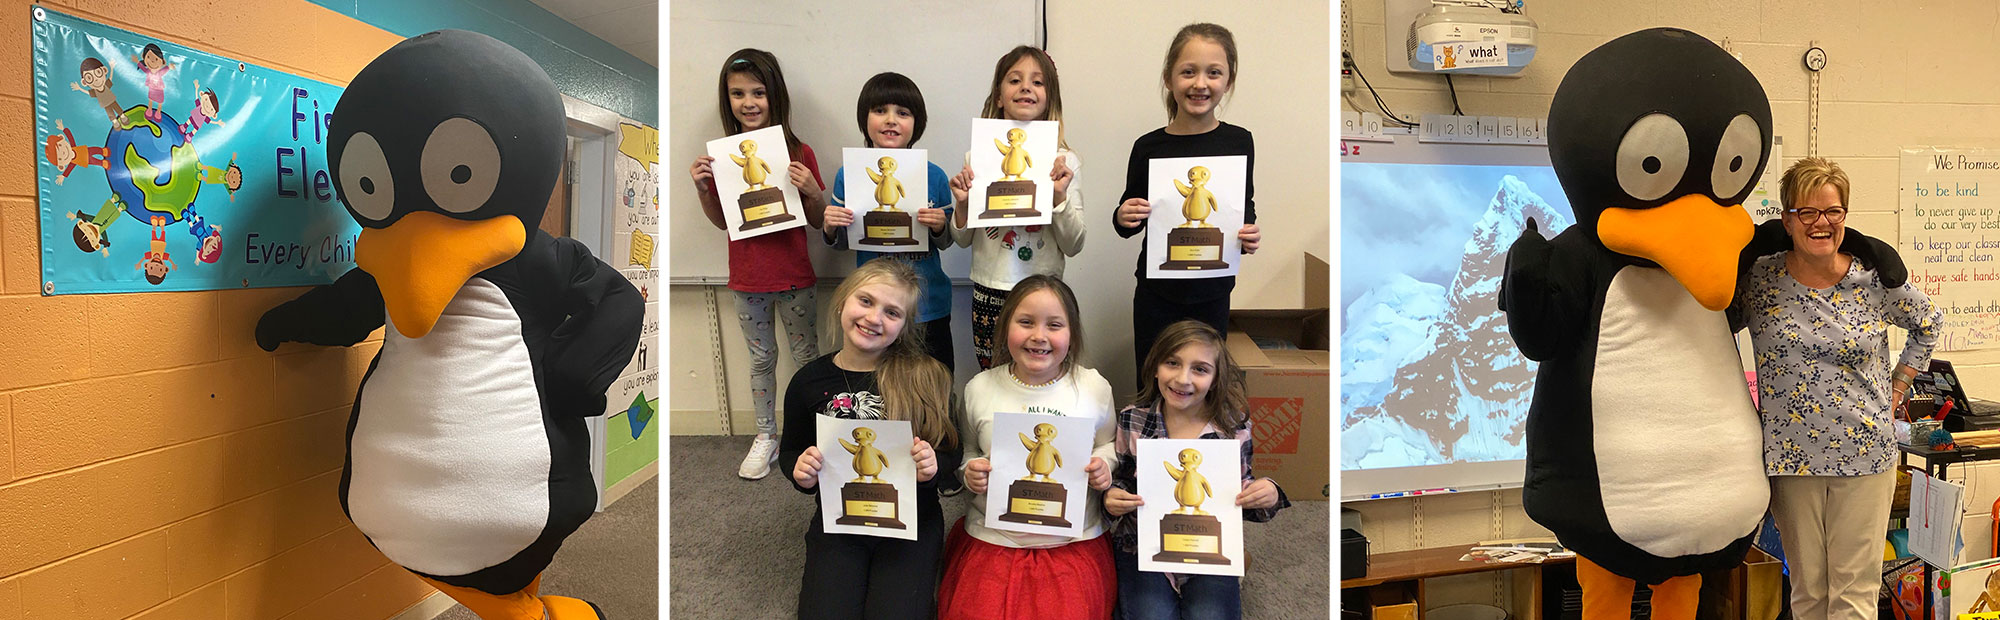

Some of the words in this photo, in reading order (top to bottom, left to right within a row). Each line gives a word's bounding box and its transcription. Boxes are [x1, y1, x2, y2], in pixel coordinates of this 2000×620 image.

[1480, 27, 1499, 35] EPSON
[1469, 45, 1498, 58] what
[291, 87, 334, 145] Fi
[1345, 120, 1354, 131] 9
[1367, 121, 1379, 133] 10
[1425, 122, 1433, 133] 11
[1444, 123, 1455, 135] 12
[1463, 124, 1474, 136] 13
[1483, 124, 1494, 136] 14
[1503, 125, 1514, 137] 15
[1522, 126, 1533, 137] 16
[1352, 145, 1360, 155] z
[1934, 154, 1954, 170] We
[1958, 154, 2000, 170] Promise
[276, 146, 341, 202] Ele
[1916, 182, 1929, 197] to
[1936, 182, 1950, 197] be
[1955, 182, 1979, 197] kind
[1915, 203, 1926, 217] to
[1929, 208, 1955, 217] never
[1958, 208, 1977, 221] give
[1980, 208, 1994, 221] up
[1924, 217, 1937, 230] do
[1941, 220, 1957, 230] our
[1960, 220, 1977, 233] very
[1980, 217, 2000, 230] best
[246, 233, 312, 270] Every
[1913, 235, 1925, 251] to
[1929, 236, 1952, 255] keep
[1955, 240, 1971, 250] our
[1924, 249, 1943, 263] neat
[1947, 250, 1964, 263] and
[1969, 249, 1994, 262] clean
[1911, 268, 1922, 284] to
[1925, 268, 1948, 284] have
[1950, 267, 1969, 282] safe
[1973, 267, 2000, 282] hands
[1951, 301, 1961, 315] to
[1963, 299, 1984, 314] each
[1260, 419, 1301, 454] DEPOT
